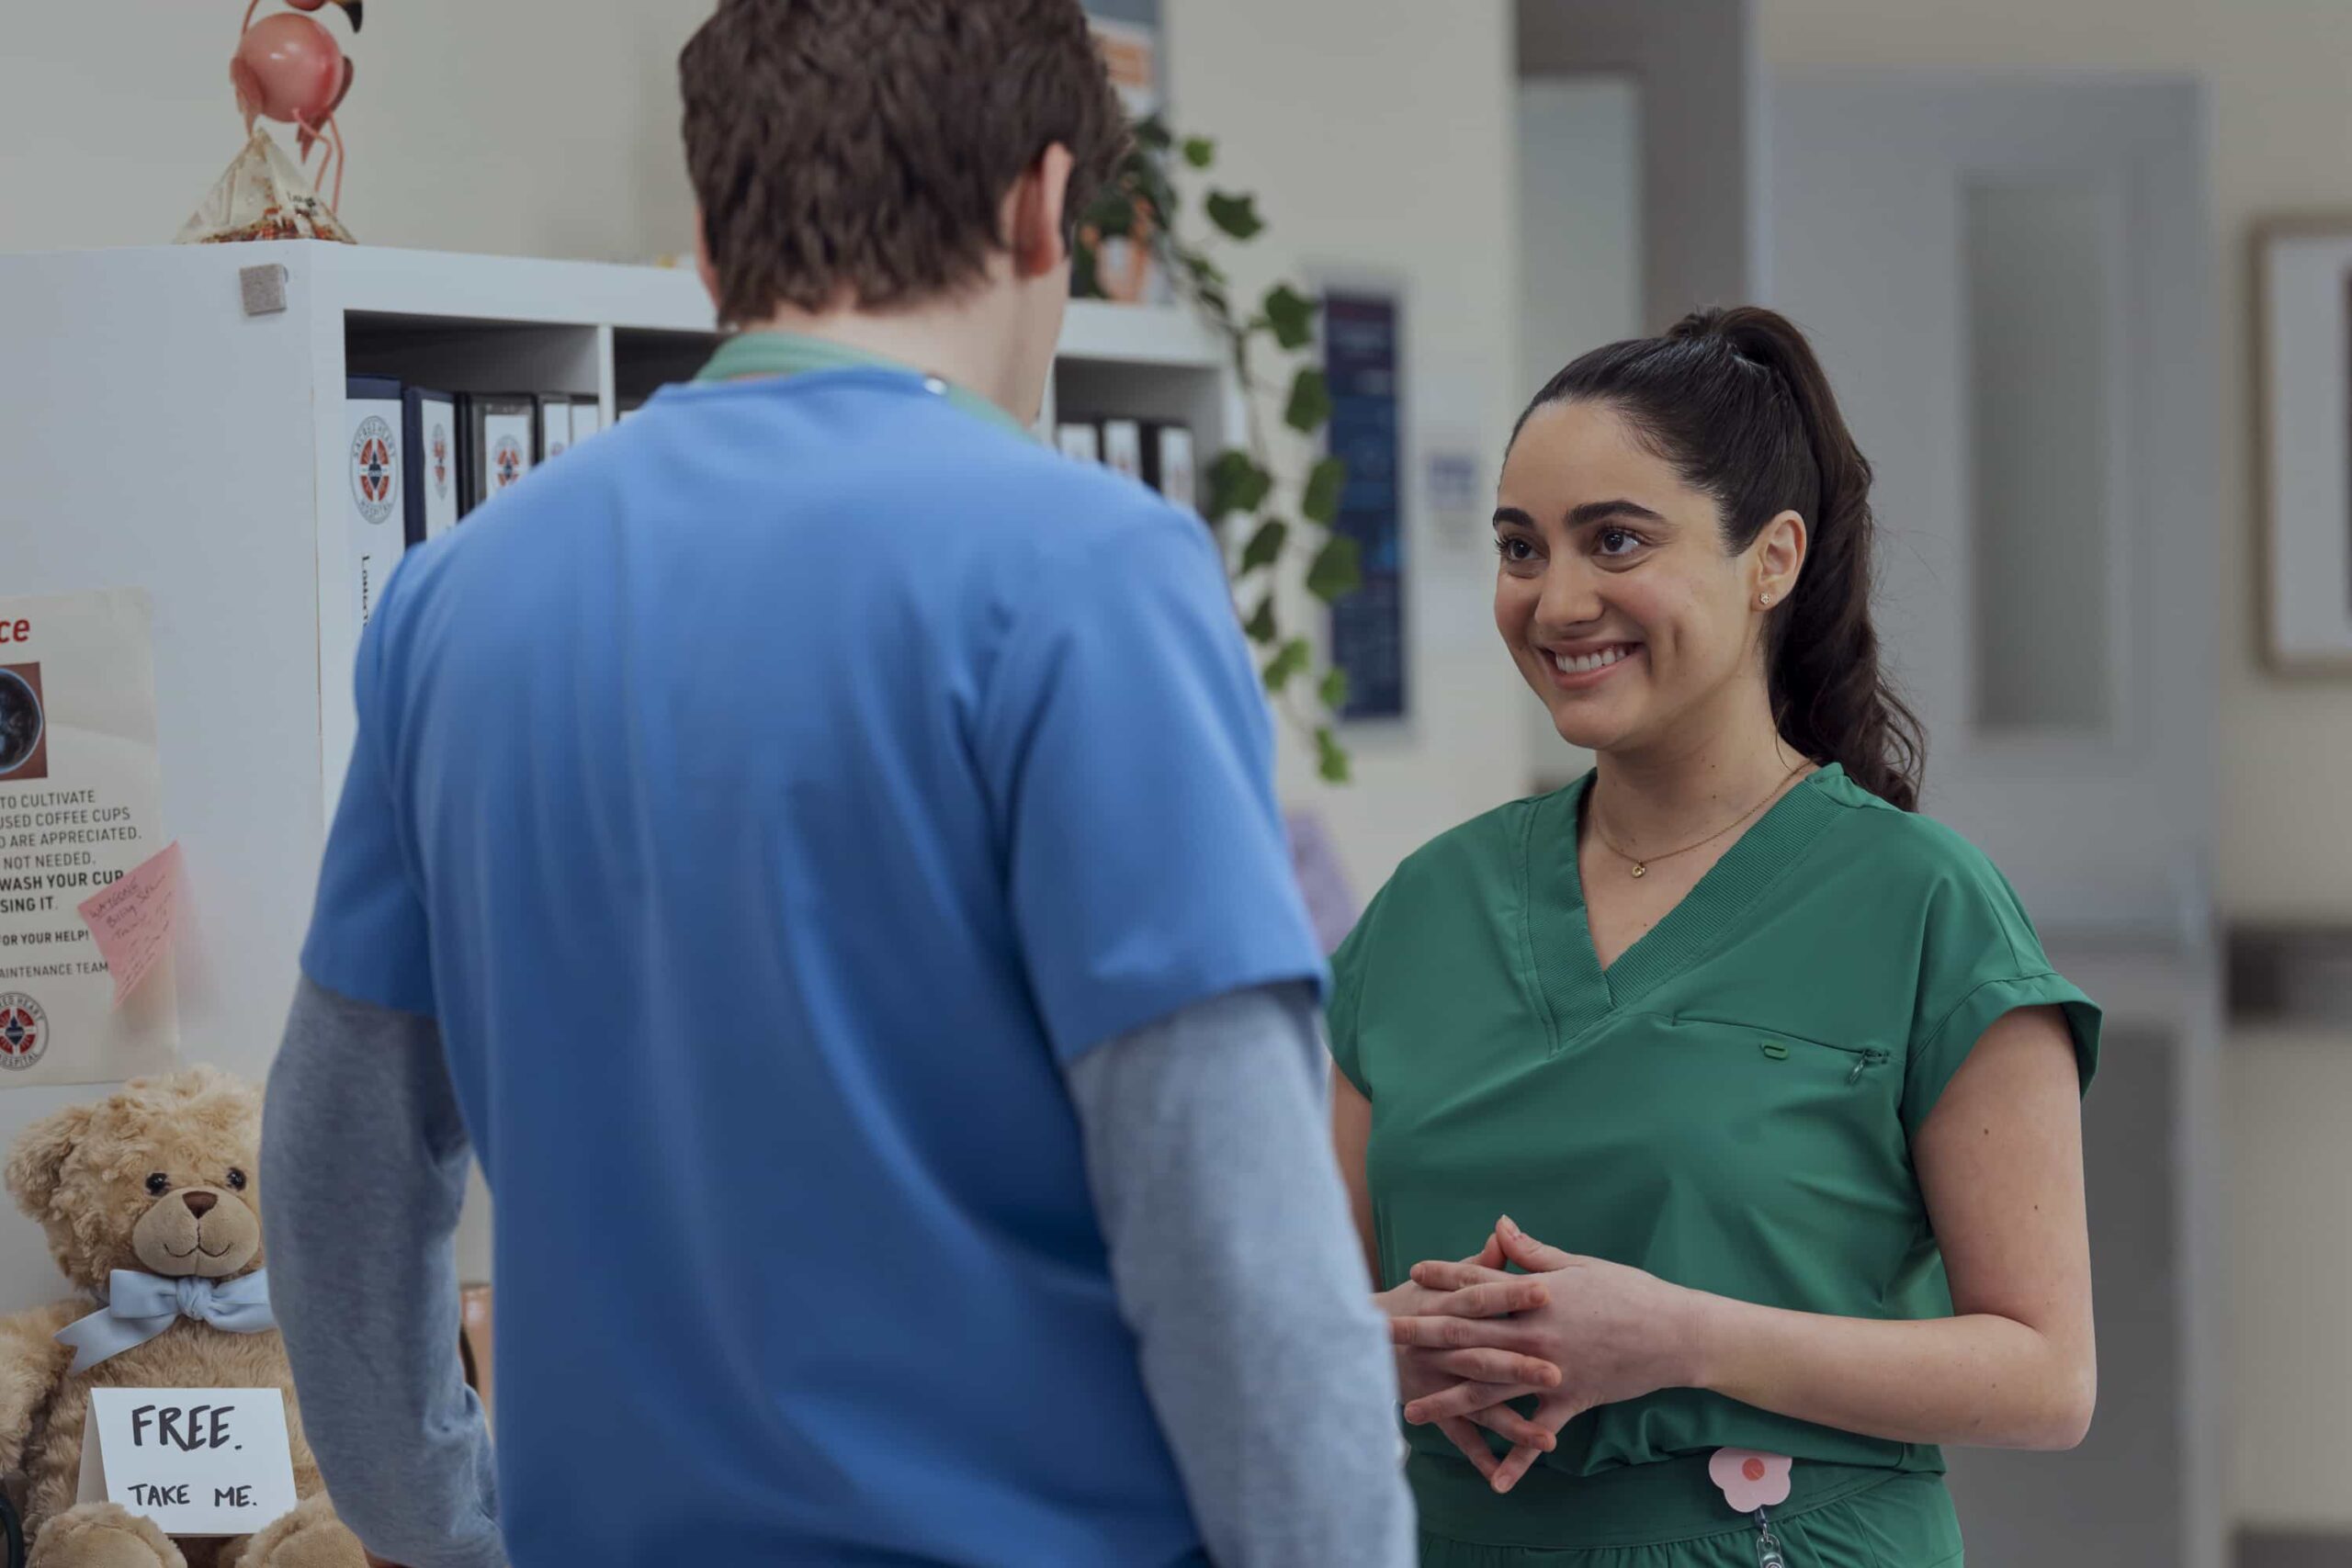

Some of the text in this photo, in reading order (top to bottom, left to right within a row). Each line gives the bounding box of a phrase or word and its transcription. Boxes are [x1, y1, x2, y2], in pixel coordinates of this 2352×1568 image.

[0, 619, 30, 643] ce
[0, 790, 96, 809] TO CULTIVATE
[36, 809, 89, 827] COFFEE
[92, 807, 131, 822] CUPS
[9, 834, 37, 848] ARE
[40, 827, 142, 845] APPRECIATED.
[4, 855, 31, 870] NOT
[0, 870, 125, 891] WASH YOUR CUP
[0, 897, 36, 913] SING
[0, 930, 89, 946] OR YOUR HELP!
[76, 962, 108, 975] TEAM
[131, 1404, 243, 1451] FREE.
[128, 1483, 257, 1507] TAKE ME.
